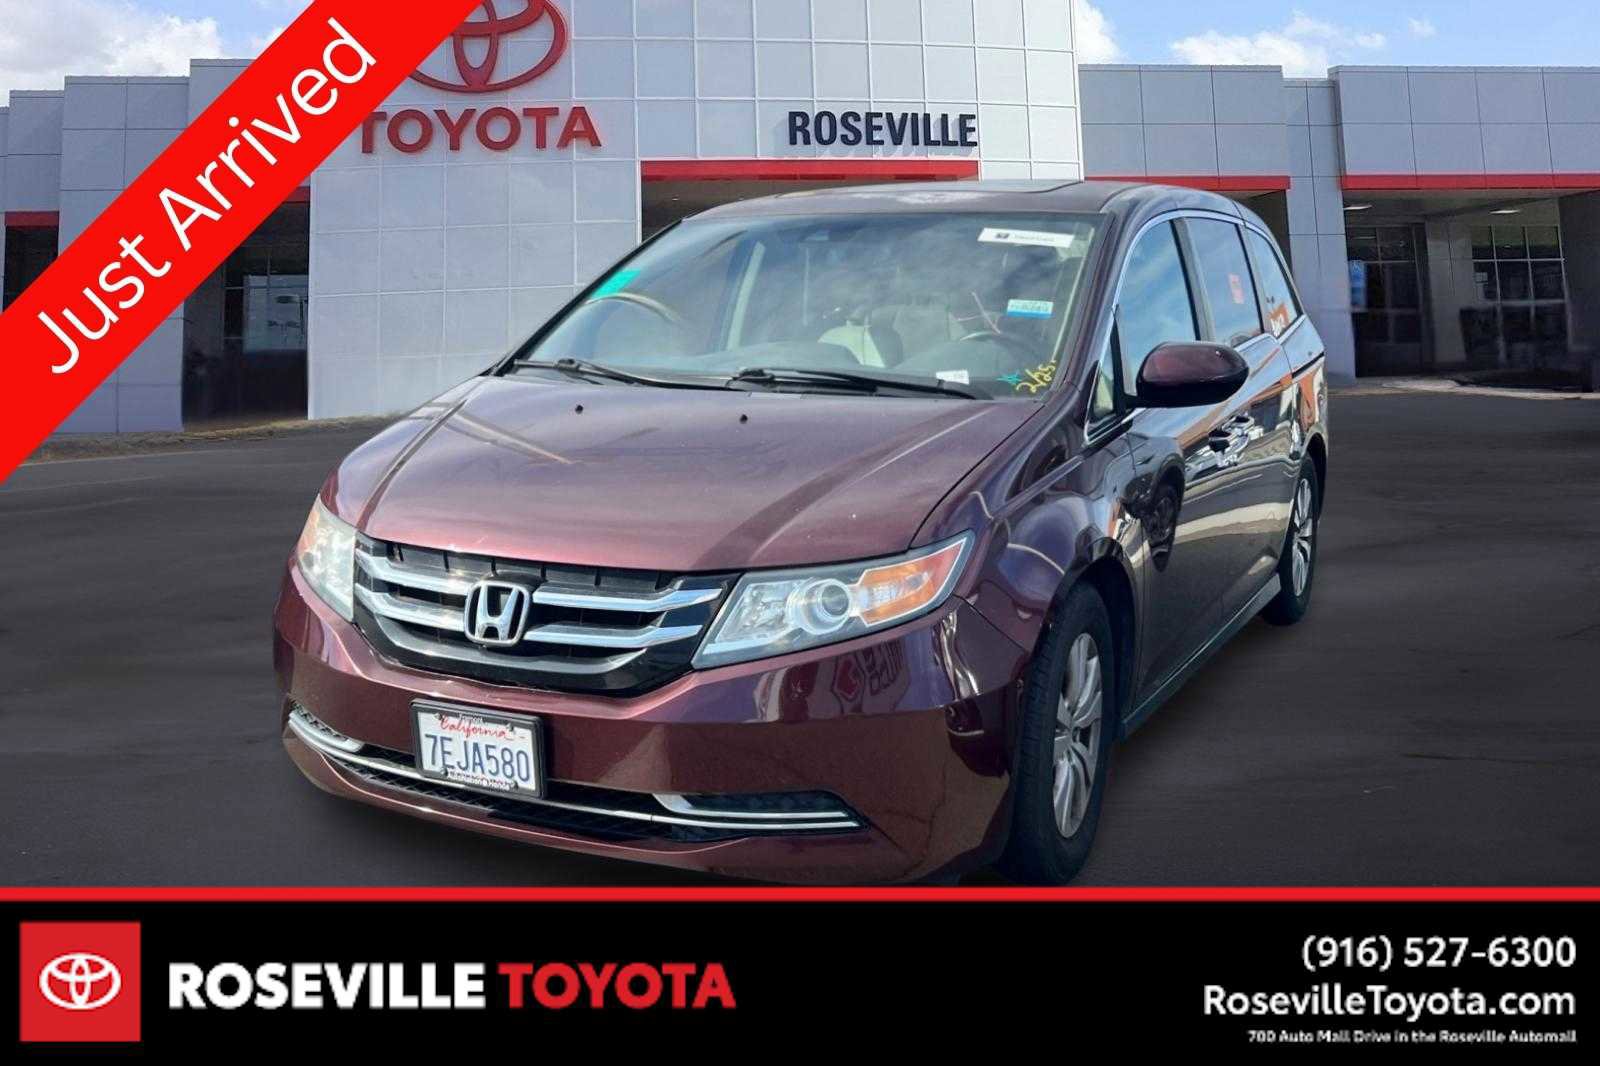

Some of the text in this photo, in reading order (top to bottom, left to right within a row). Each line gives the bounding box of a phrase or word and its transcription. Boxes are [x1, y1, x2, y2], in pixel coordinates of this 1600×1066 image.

[361, 107, 602, 154] TOYOTA
[788, 111, 978, 147] ROSEVILLE
[440, 714, 513, 740] California
[424, 733, 530, 782] 7EJA580
